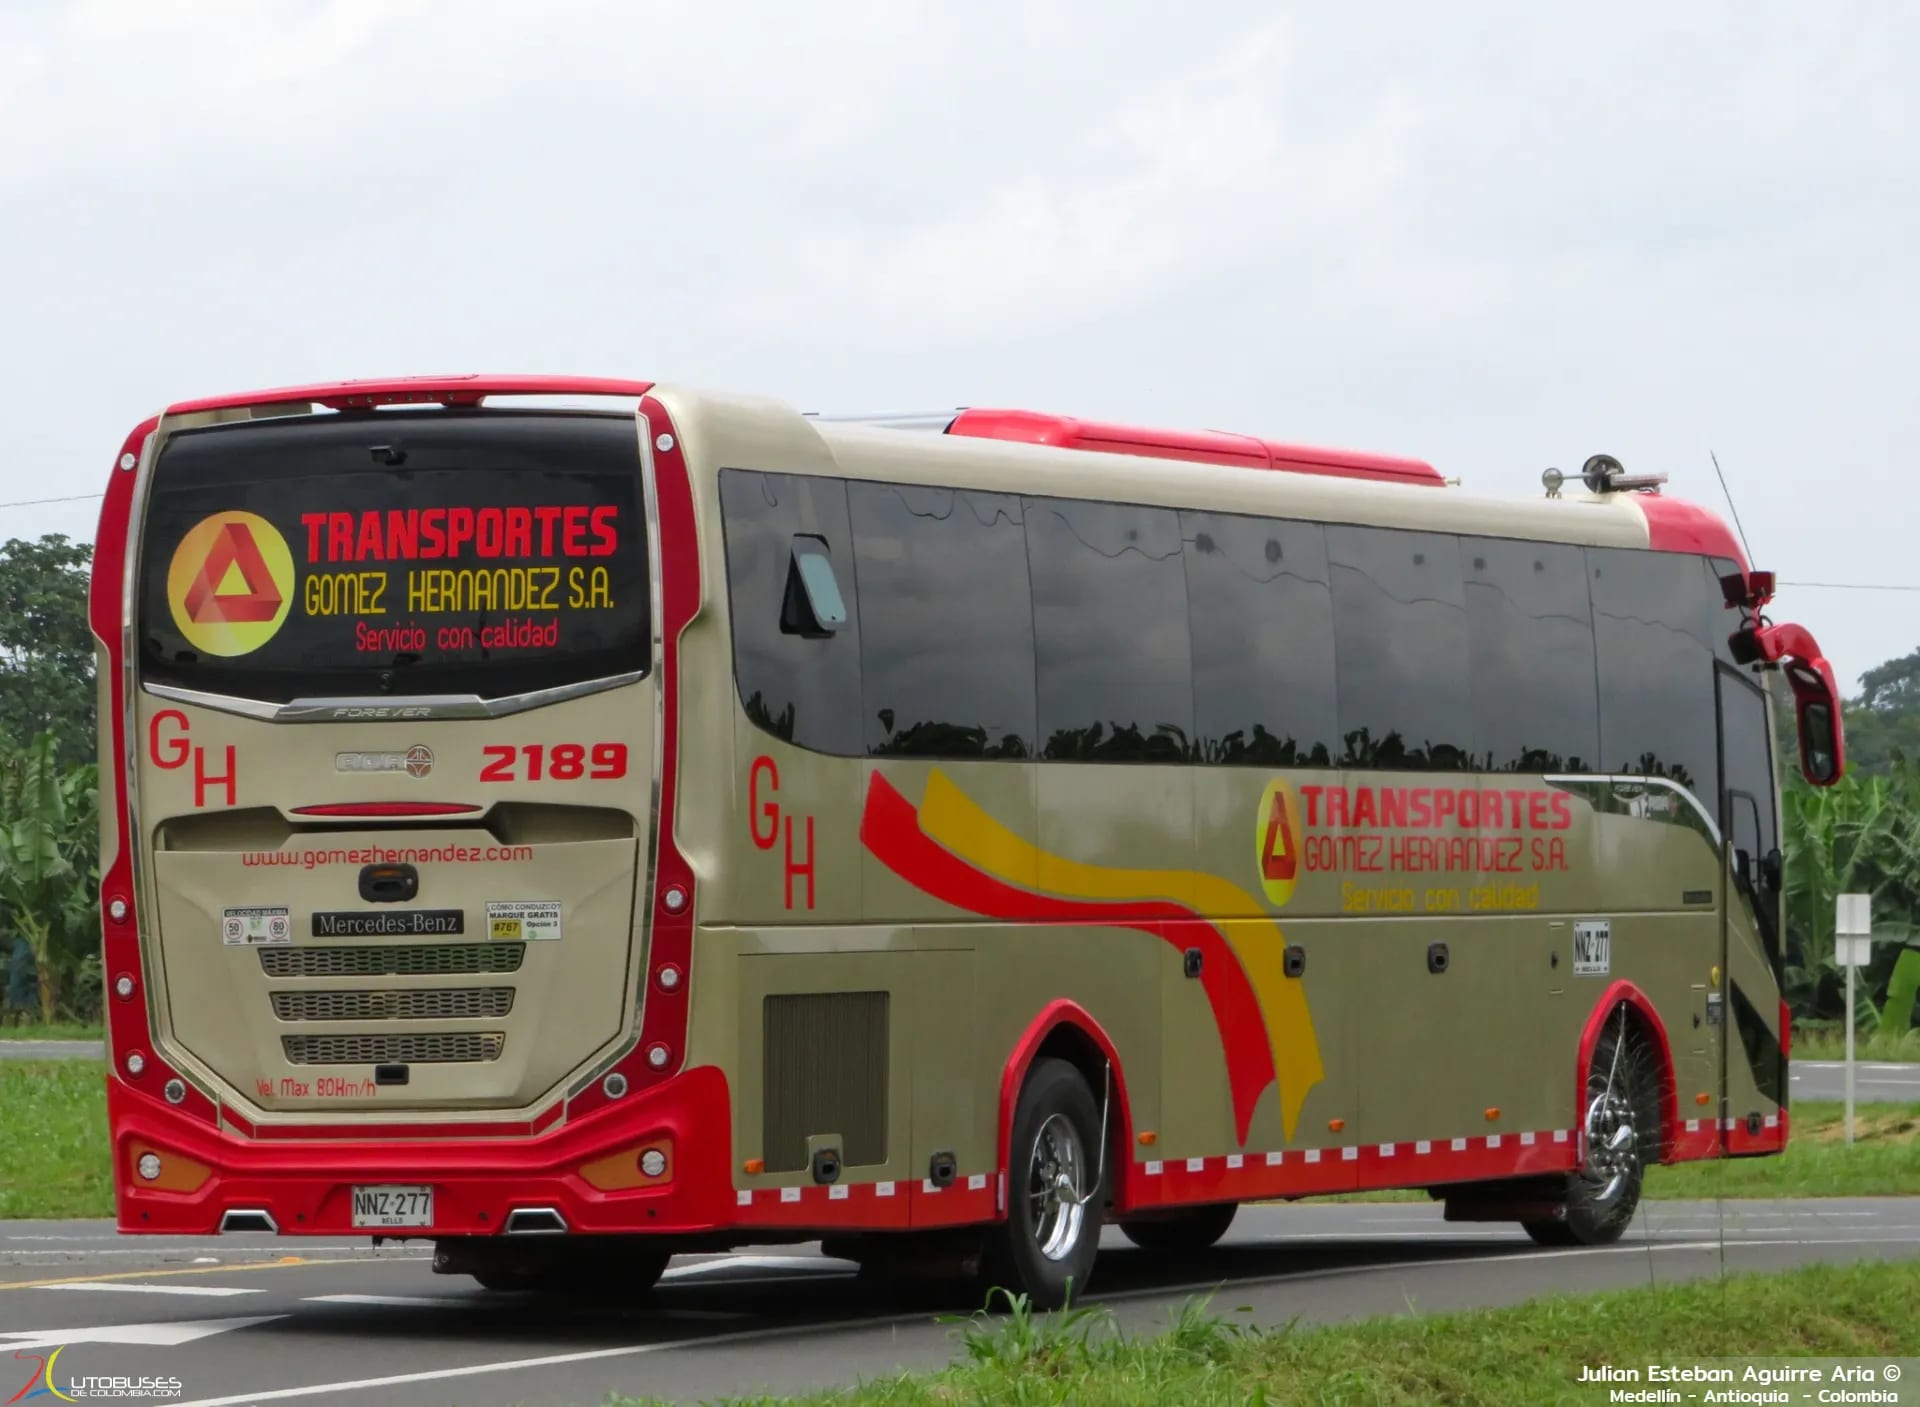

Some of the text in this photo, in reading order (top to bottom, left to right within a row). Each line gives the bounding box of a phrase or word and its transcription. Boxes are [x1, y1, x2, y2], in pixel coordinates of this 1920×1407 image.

[301, 505, 618, 563] TRANSPORTES
[305, 566, 615, 616] GOMEZ HERNANDEZ S.A.
[356, 617, 559, 651] Servicio con calidad
[479, 743, 628, 782] 2189
[1301, 786, 1572, 830] TRANSPORTES
[242, 845, 533, 869] www.gomezhernandez.com
[1304, 835, 1569, 873] GOMEZ HERNANDEZ S.A.
[1342, 880, 1540, 912] Servicio con calidad
[228, 922, 240, 932] 50
[319, 914, 457, 934] Mercedes-Benz
[280, 1078, 309, 1097] Max
